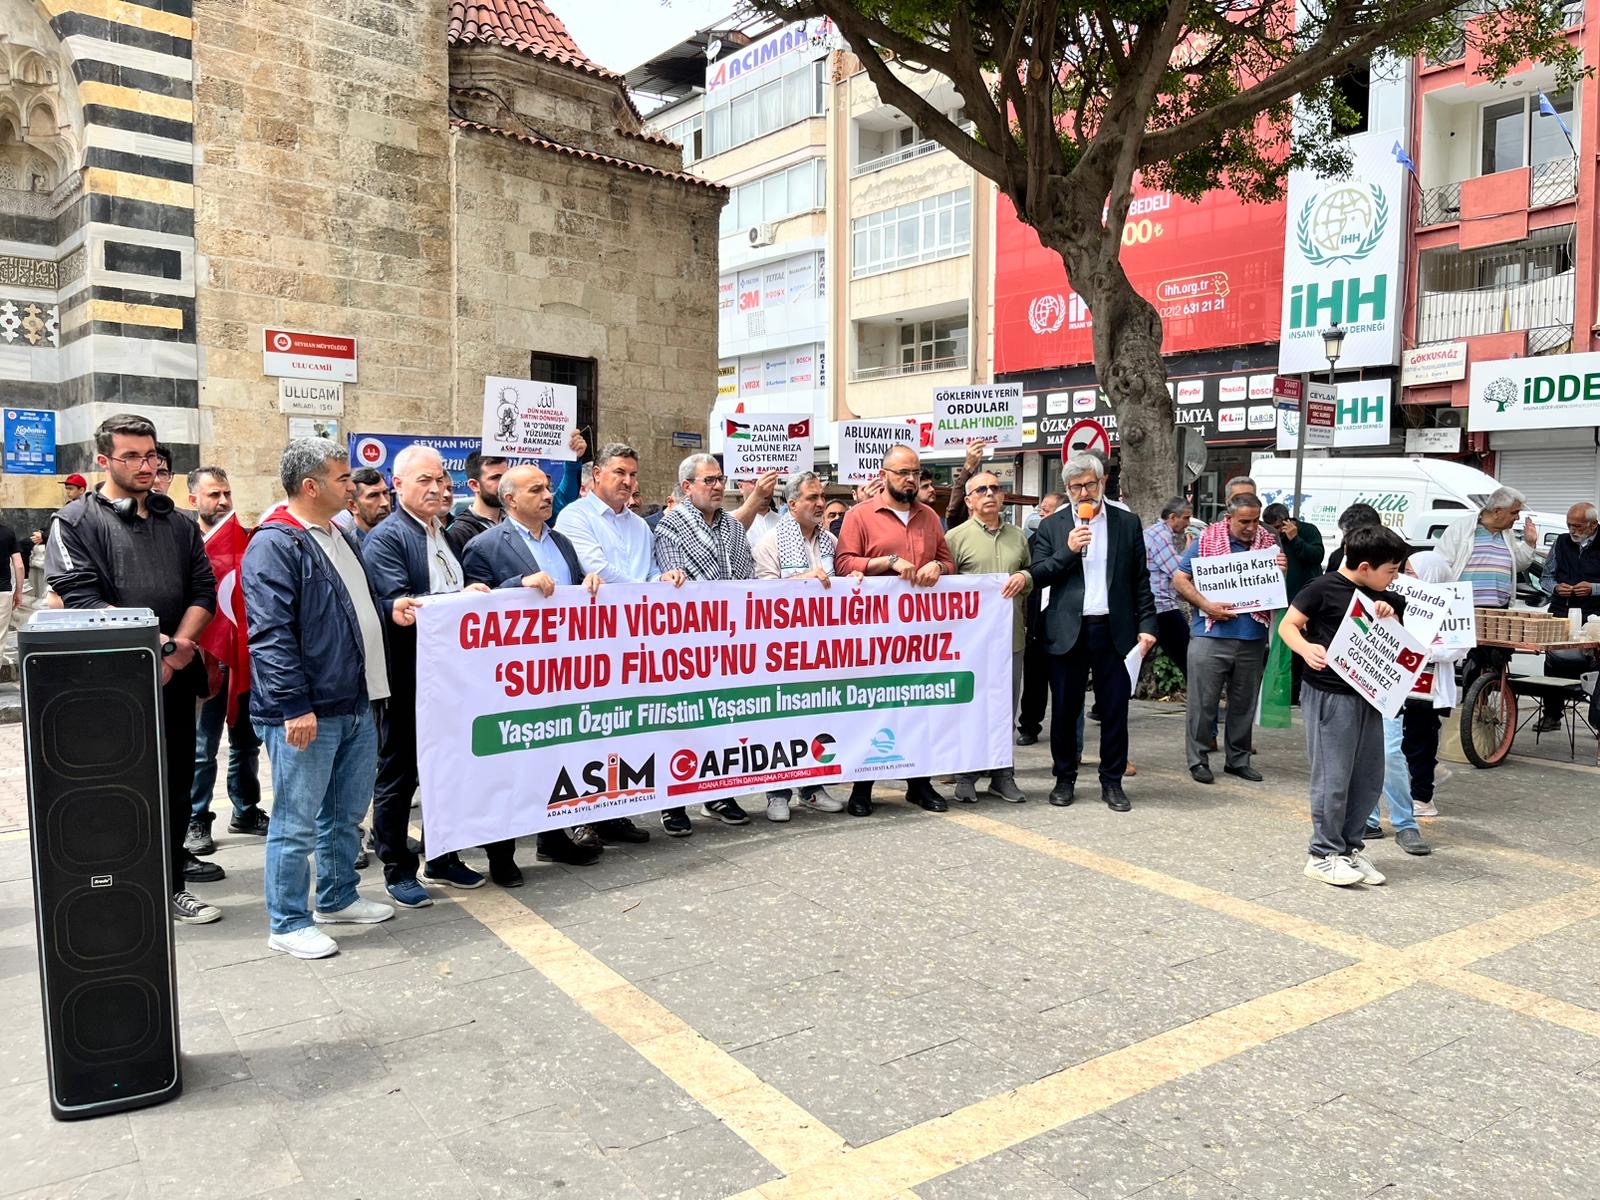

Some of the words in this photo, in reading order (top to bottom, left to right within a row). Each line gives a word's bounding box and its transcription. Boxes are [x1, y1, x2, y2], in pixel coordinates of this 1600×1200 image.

[1164, 280, 1209, 296] ihh.org.tr
[740, 290, 759, 311] 3M
[1159, 305, 1181, 318] 0212
[1183, 303, 1199, 315] 631
[1201, 301, 1212, 312] 21
[1214, 298, 1225, 310] 21
[796, 356, 811, 364] BOSCH
[719, 385, 735, 393] TANLEY
[936, 389, 980, 401] GÖKLERİN
[982, 389, 993, 399] VE
[994, 387, 1019, 398] YERİN
[1309, 392, 1336, 401] CEYLAN
[947, 401, 1009, 415] ORDULARI
[540, 423, 565, 431] DÖNERSE
[753, 424, 785, 432] ADANA
[938, 415, 1018, 430] ALLAH'INDIR.
[523, 437, 562, 446] BAKMAZSA!
[525, 430, 562, 439] YÜZÜMÜZE
[751, 433, 788, 442] ZALİMİN
[844, 425, 892, 440] ABLUKAYI
[894, 428, 914, 442] KIR,
[737, 443, 780, 452] ZULMÜNE
[782, 444, 802, 452] RIZA
[742, 453, 798, 462] GÖSTERMEZ!
[1196, 561, 1249, 576] Barbarlığa
[1251, 558, 1277, 570] Karşı
[1198, 578, 1238, 591] İnsanlık
[1240, 572, 1280, 587] İttifakı!
[1405, 586, 1446, 607] Sularda
[459, 597, 617, 650] GAZZE'NİN
[624, 594, 737, 638] VİCDANI,
[745, 588, 890, 631] İNSANLIĞIN
[899, 590, 980, 624] ONURU
[1372, 623, 1400, 650] ADANA
[1365, 632, 1397, 663] ZALİMİN
[621, 642, 757, 685] FİLOSU'NU
[765, 631, 961, 673] SELAMLIYORUZ.
[1349, 633, 1385, 667] ZULMÜNE
[1383, 666, 1402, 684] RIZA
[1347, 647, 1393, 691] GÖSTERMEZ!
[498, 716, 573, 749] Yaşasın
[578, 704, 633, 737] Özgür
[637, 698, 705, 727] Filistin!
[707, 694, 771, 723] Yaşasın
[776, 685, 842, 712] İnsanlık
[846, 678, 956, 706] Dayanışması!
[698, 782, 719, 791] ADANA
[743, 774, 777, 785] DAYANIŞMA
[777, 769, 812, 781] PLATFORMU
[547, 809, 572, 818] ADANA
